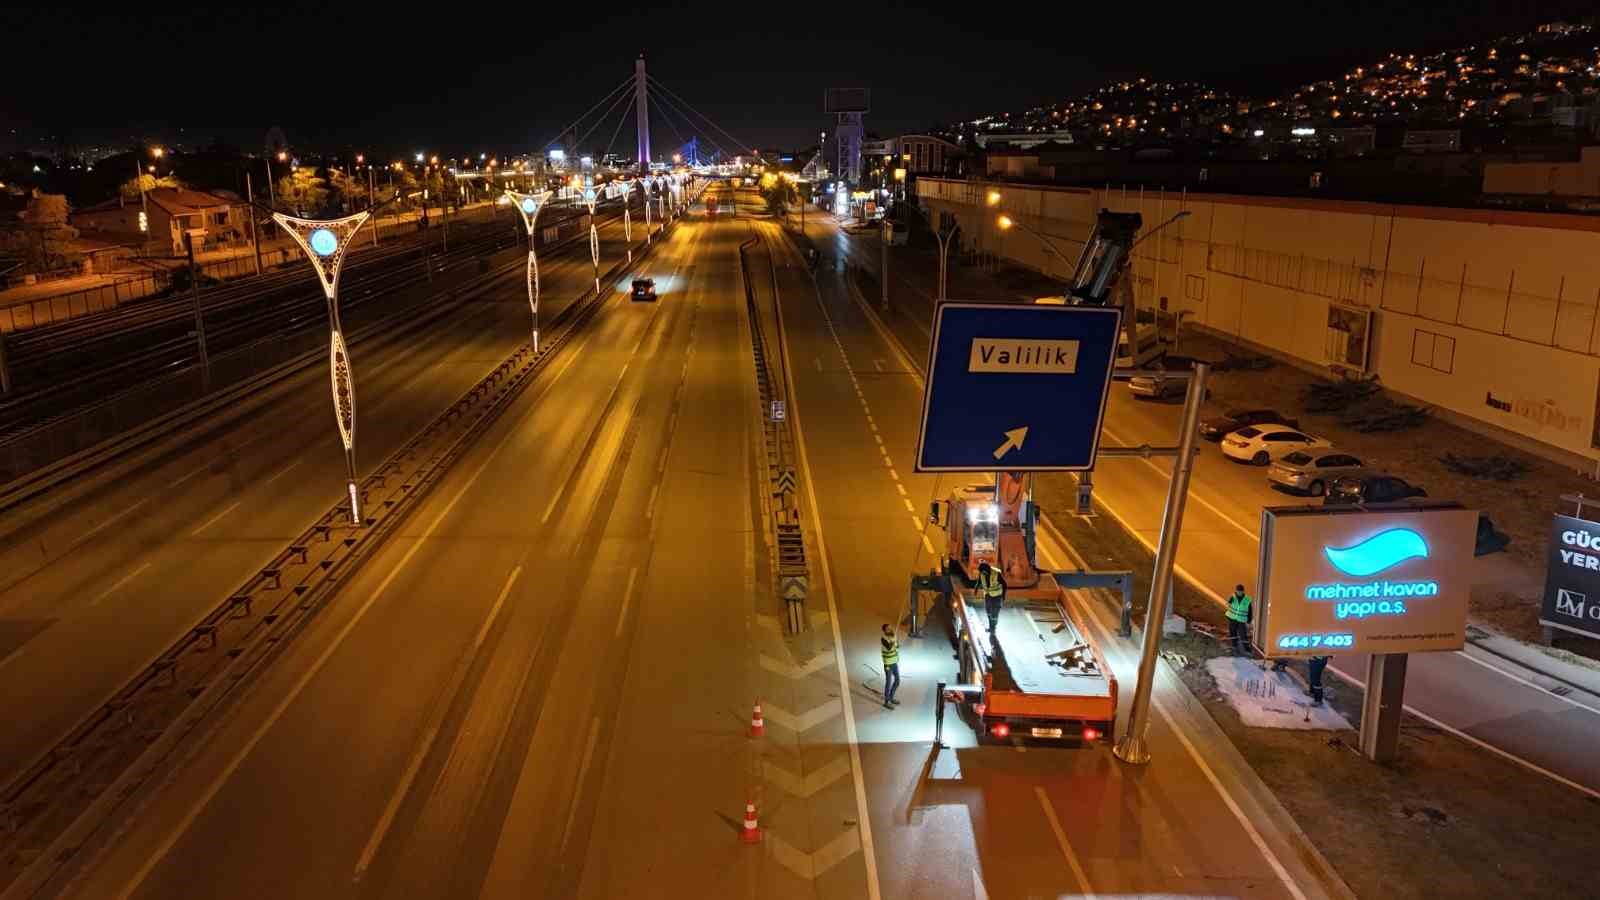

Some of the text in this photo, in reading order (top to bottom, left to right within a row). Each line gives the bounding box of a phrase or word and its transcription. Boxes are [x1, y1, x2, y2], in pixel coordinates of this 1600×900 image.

[980, 344, 1068, 365] Valilik
[1560, 549, 1600, 571] YER
[1307, 581, 1438, 599] mehmet kavan
[1279, 636, 1309, 648] 444
[1311, 635, 1322, 647] 7
[1324, 634, 1353, 647] 403
